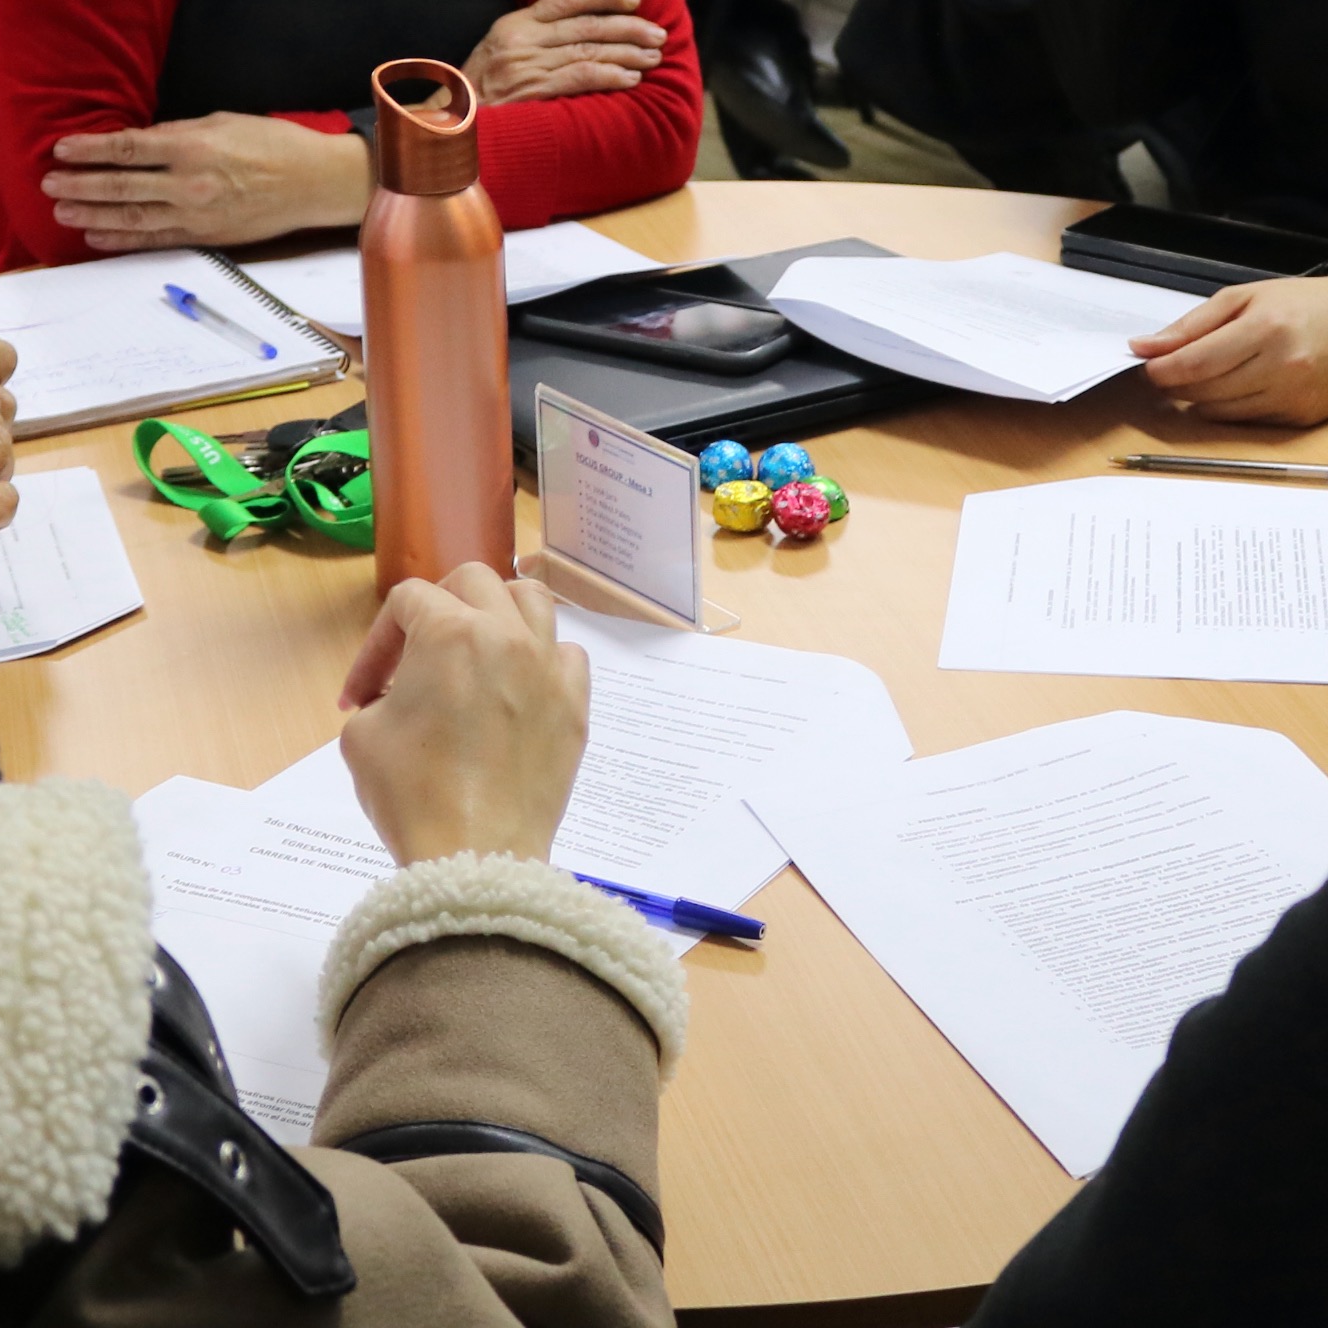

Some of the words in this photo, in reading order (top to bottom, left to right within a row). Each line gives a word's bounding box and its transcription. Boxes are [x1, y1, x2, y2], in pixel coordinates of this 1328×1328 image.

[189, 435, 221, 465] ULS
[576, 452, 598, 470] FOCUS
[599, 463, 623, 480] GROUP
[628, 477, 647, 493] Mesa
[264, 817, 285, 828] 2do
[285, 823, 352, 845] ENCUENTRO
[166, 851, 201, 865] GRUPO
[281, 838, 345, 858] EGRESADOS
[220, 865, 243, 876] 03
[249, 846, 298, 863] CARRERA
[300, 858, 314, 867] DE
[317, 861, 379, 881] INGENIERIA
[173, 878, 207, 891] Análisis
[220, 888, 233, 896] las
[234, 893, 293, 909] competencias
[294, 905, 331, 918] actuales
[173, 886, 187, 894] los
[224, 897, 261, 909] actuales
[262, 906, 279, 914] que
[280, 909, 312, 921] impone
[247, 1100, 285, 1112] afrontar
[285, 1108, 301, 1116] los
[280, 1116, 311, 1128] actual
